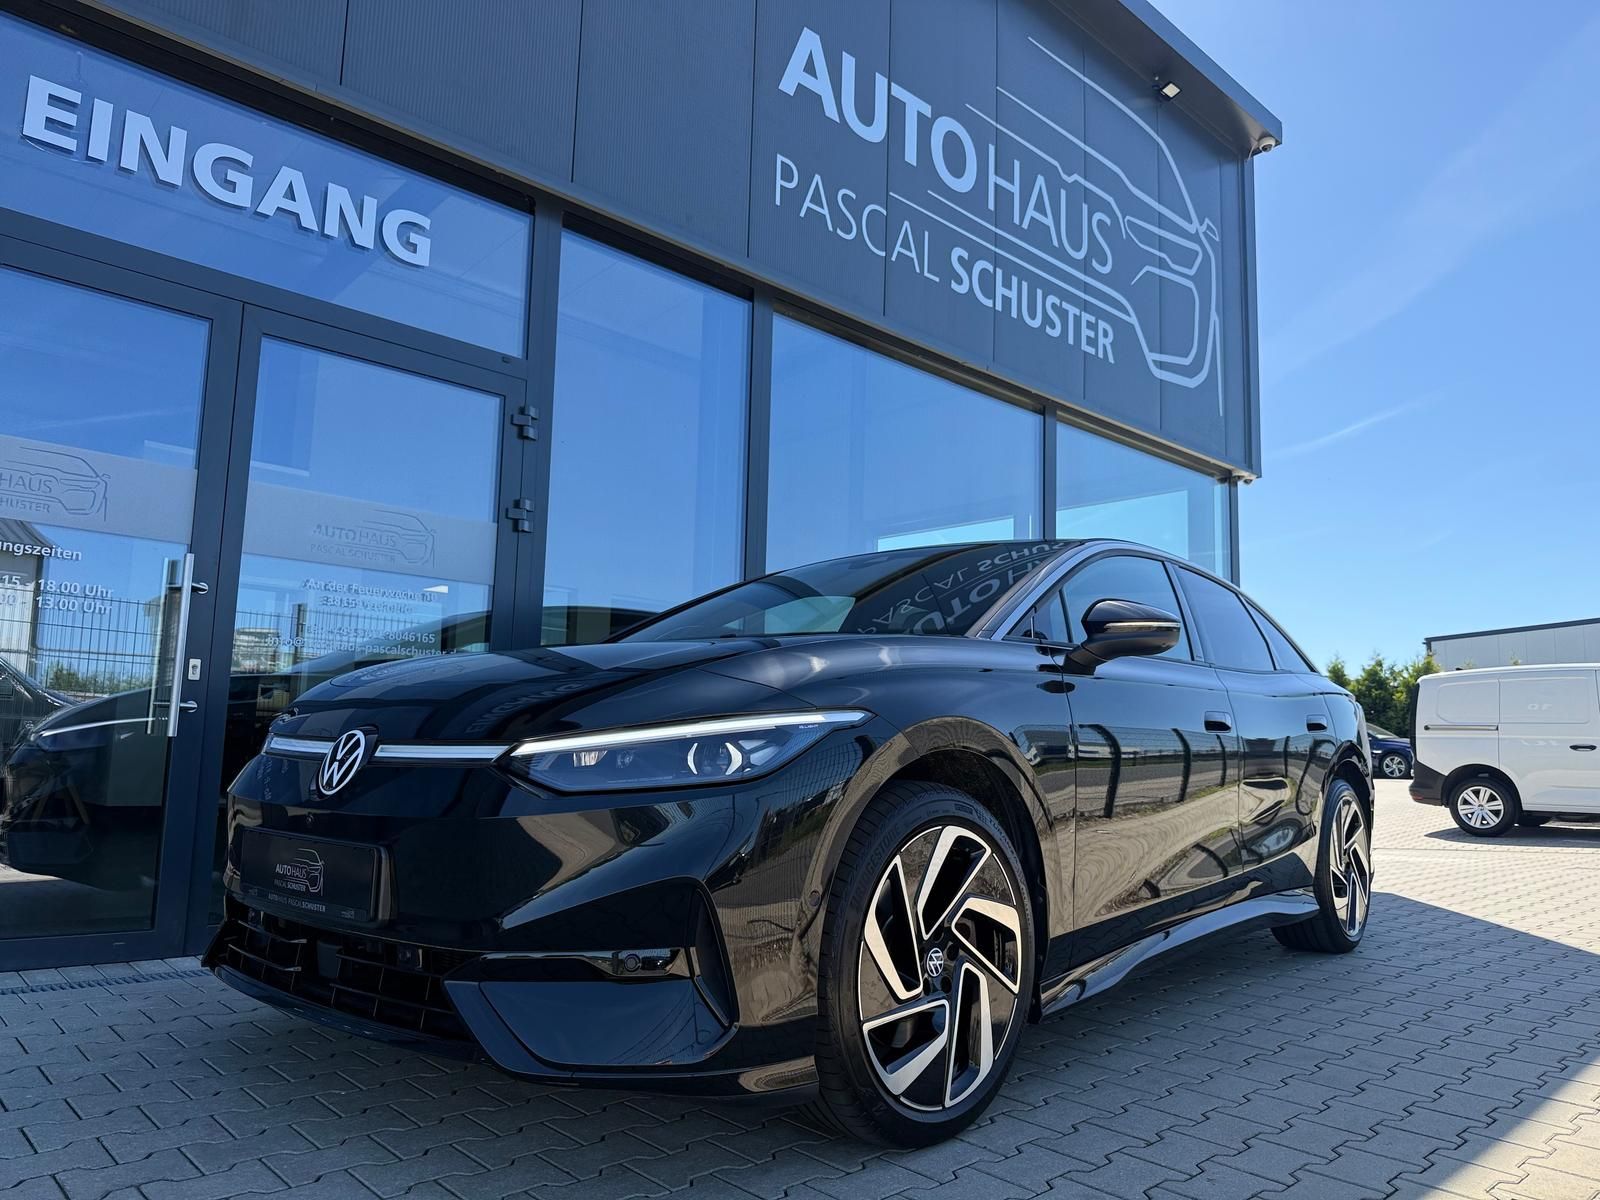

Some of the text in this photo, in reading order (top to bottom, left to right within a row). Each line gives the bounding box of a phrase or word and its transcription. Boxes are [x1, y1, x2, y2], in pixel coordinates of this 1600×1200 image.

[778, 26, 1113, 274] AUTOHAUS
[22, 75, 431, 268] EINGANG
[775, 153, 1115, 364] PASCAL SCHUSTER
[312, 523, 397, 548] AUTOHAUS
[38, 579, 80, 594] 18.00
[85, 584, 114, 598] Uhr
[36, 596, 78, 612] 13.00
[83, 601, 112, 615] Uhr
[275, 863, 307, 879] AUTOHAUS
